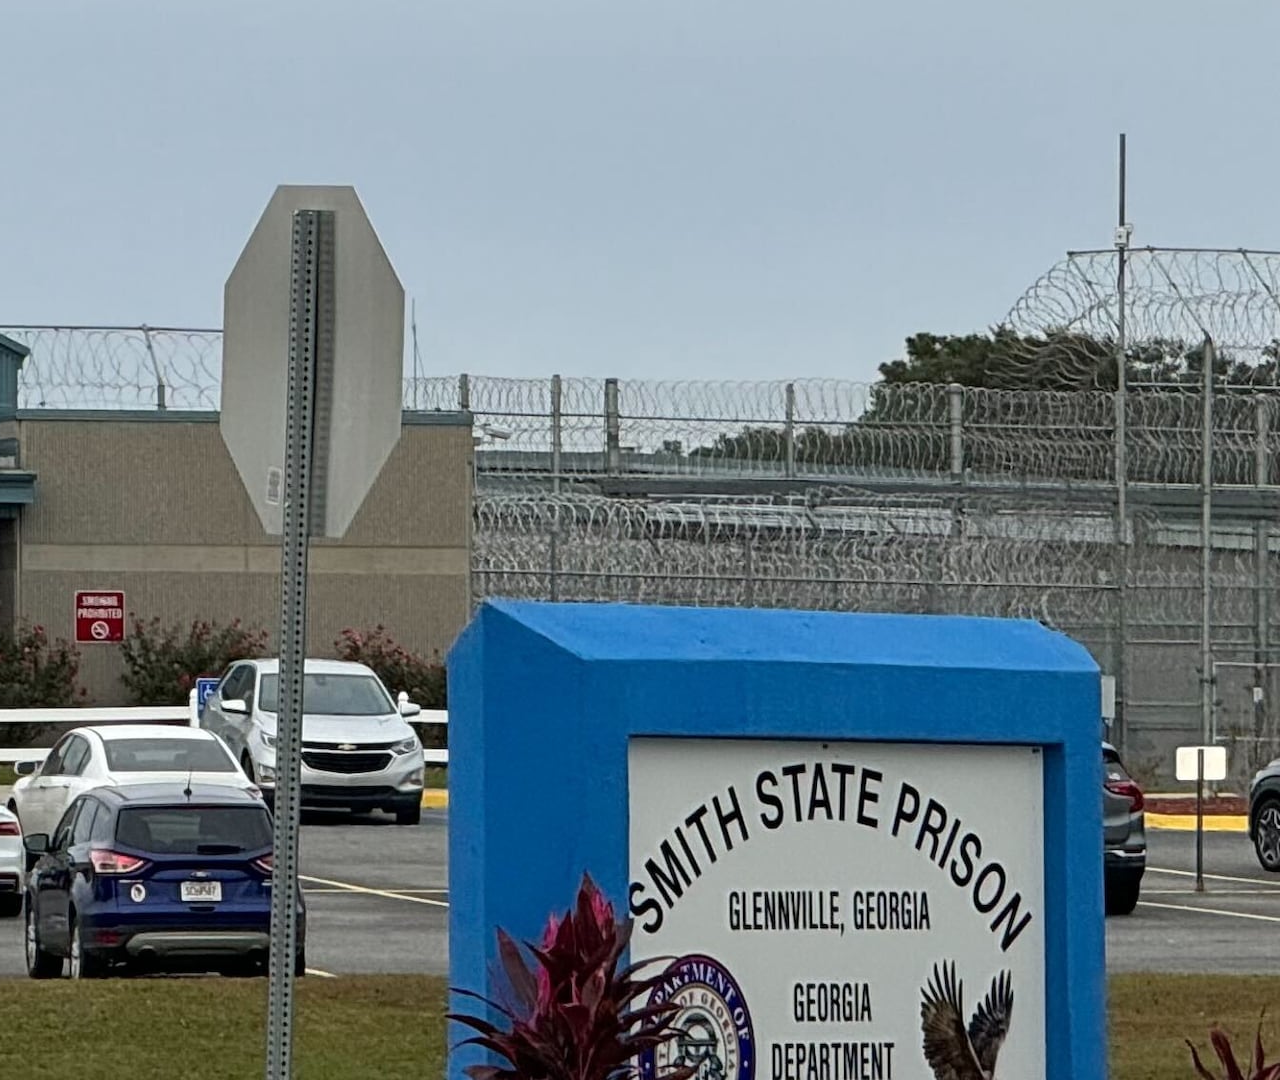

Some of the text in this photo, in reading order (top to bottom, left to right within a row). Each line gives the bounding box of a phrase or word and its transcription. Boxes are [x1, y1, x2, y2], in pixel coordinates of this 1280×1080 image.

[629, 762, 1033, 952] SMITH STATE PRISON
[729, 891, 931, 936] GLENNVILLE, GEORGIA
[793, 983, 872, 1022] GEORGIA
[733, 1007, 749, 1041] OF
[771, 1042, 894, 1080] DEPARTMENT
